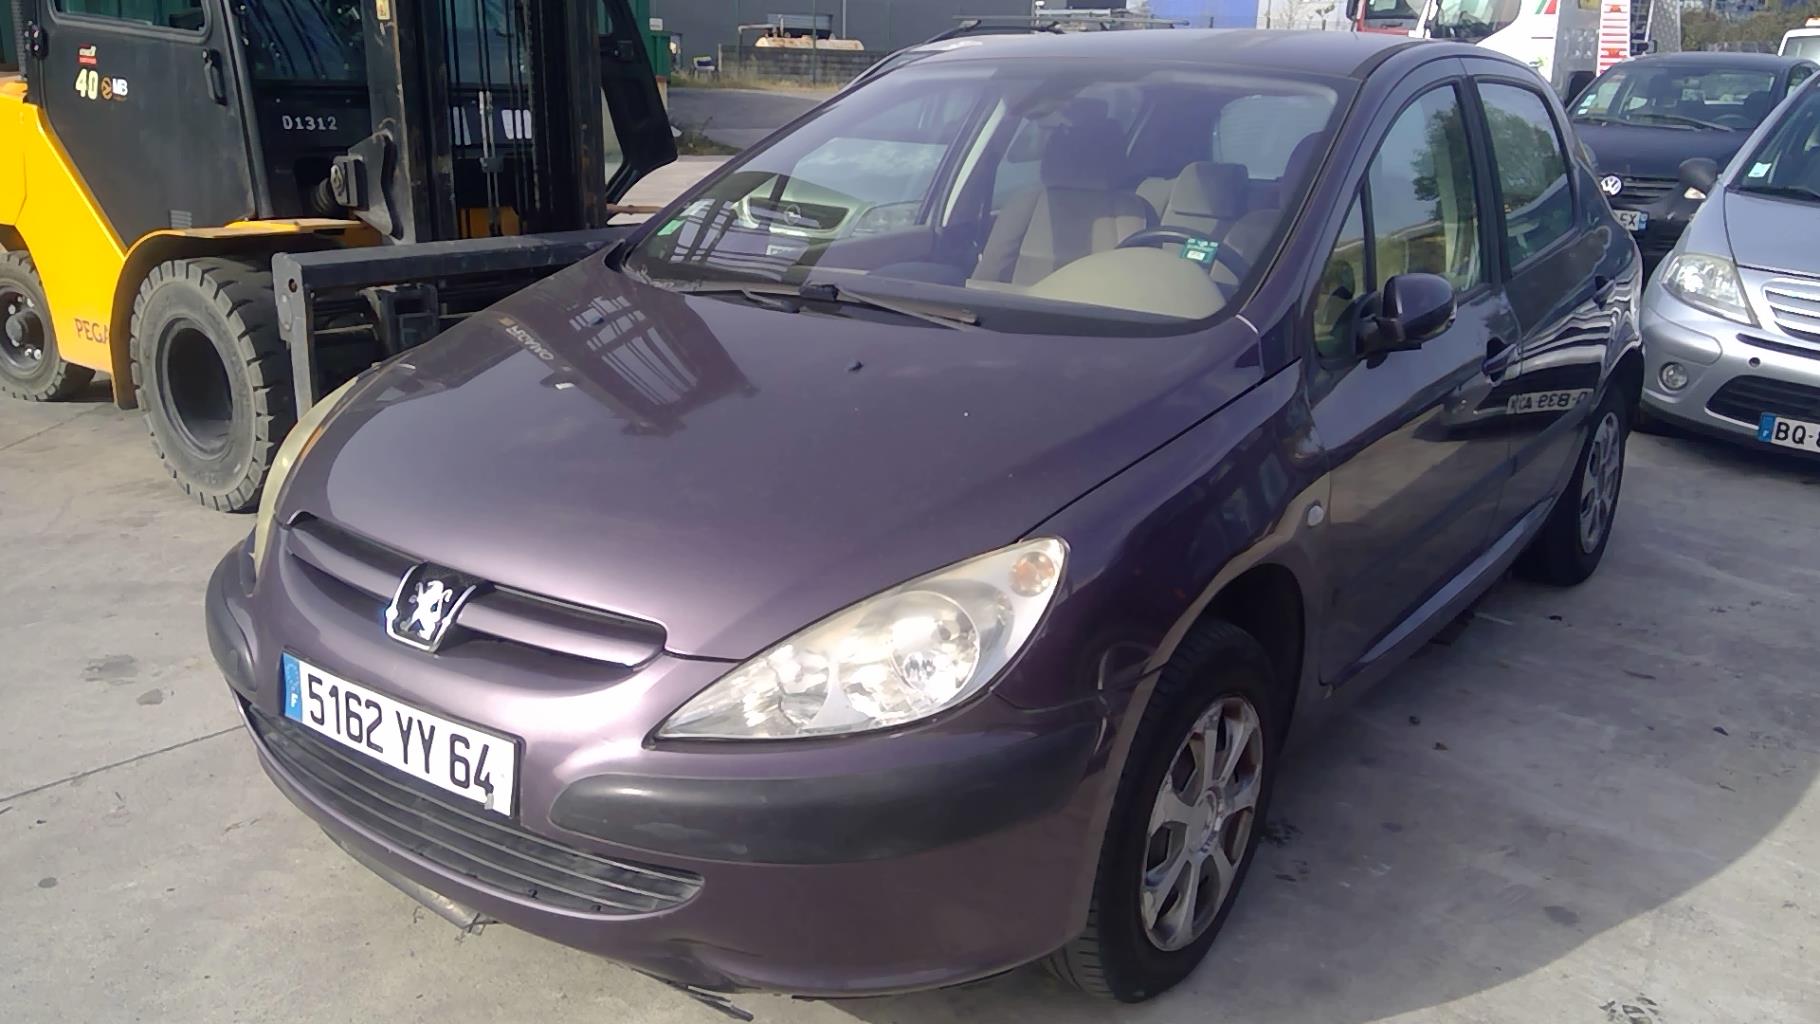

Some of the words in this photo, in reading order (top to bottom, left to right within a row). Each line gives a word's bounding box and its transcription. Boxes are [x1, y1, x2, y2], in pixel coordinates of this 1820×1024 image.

[76, 69, 98, 99] 40
[282, 115, 338, 130] D1312
[308, 673, 384, 754] 5162
[395, 710, 436, 775] YY
[449, 733, 495, 794] 64
